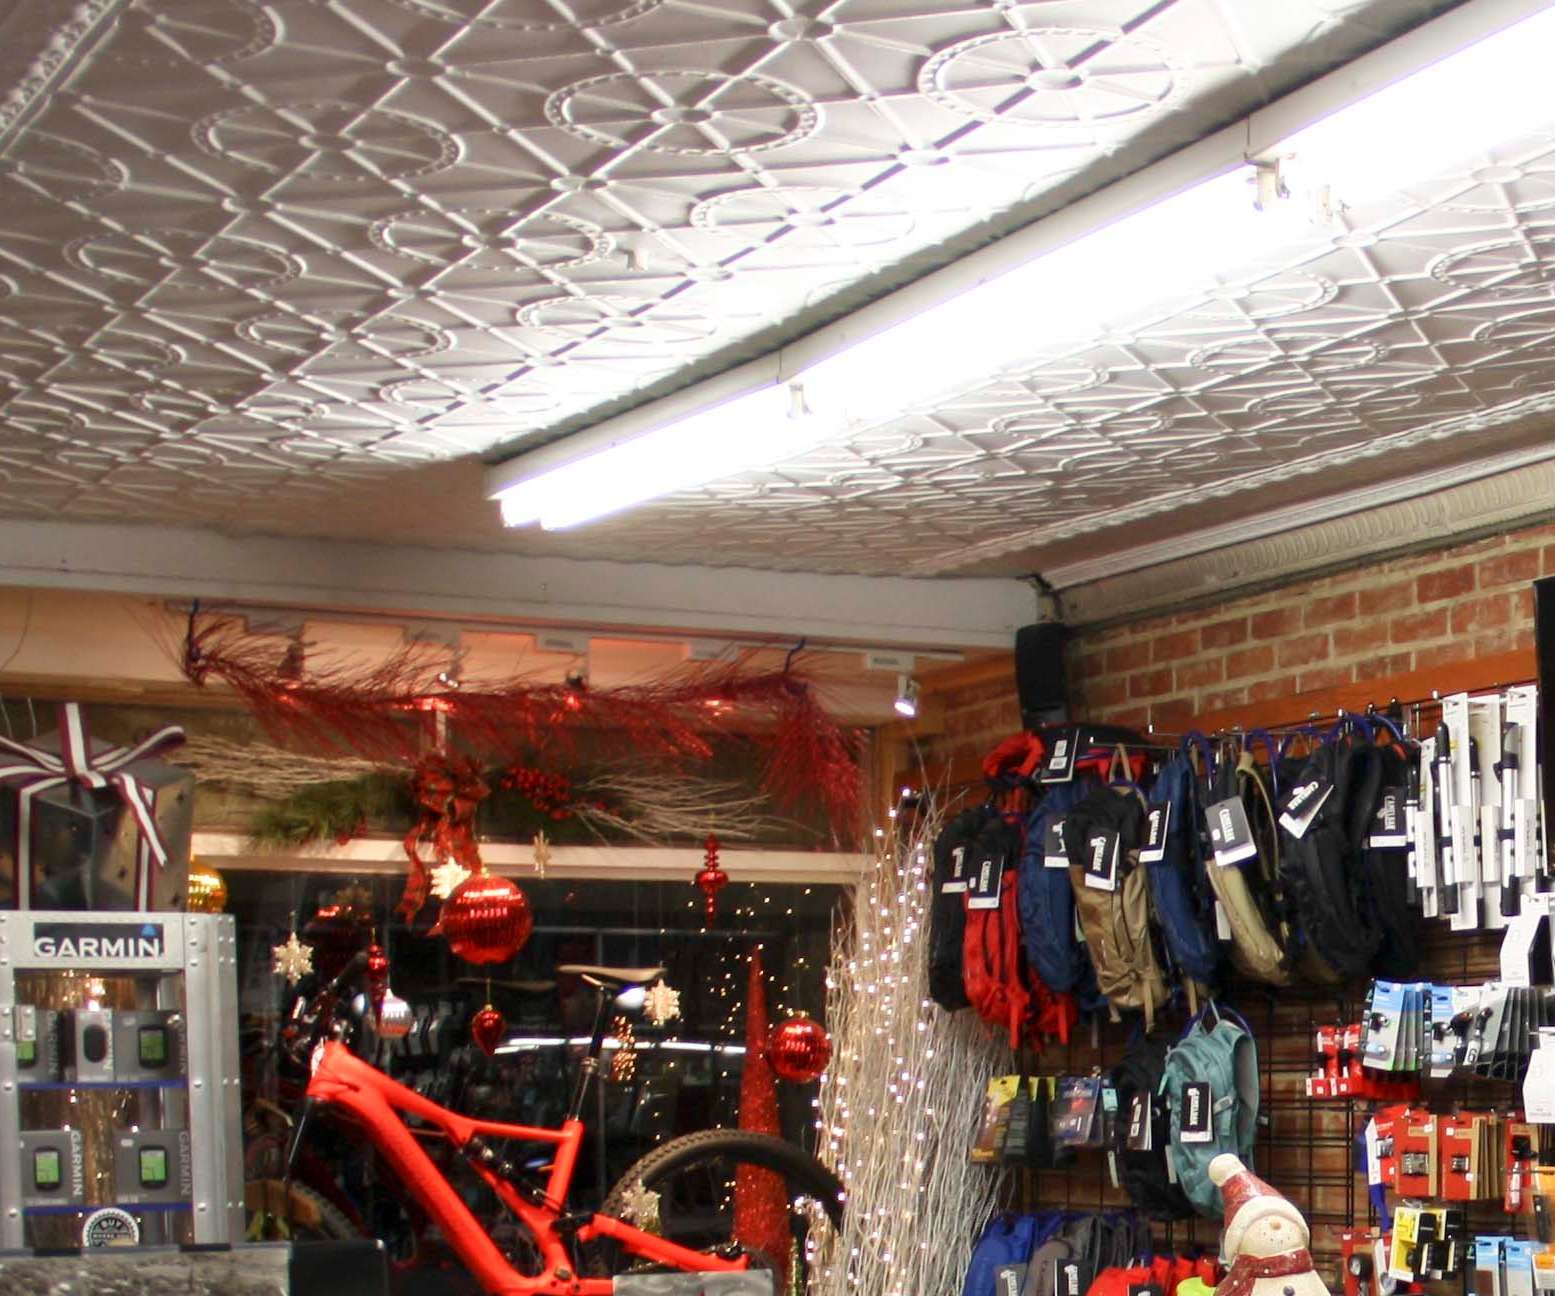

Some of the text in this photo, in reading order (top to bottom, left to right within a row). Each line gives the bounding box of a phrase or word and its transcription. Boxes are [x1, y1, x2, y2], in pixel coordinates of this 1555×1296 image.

[34, 936, 162, 958] GARMIN
[71, 1131, 83, 1197] GARMIN
[178, 1131, 192, 1197] GARMIN
